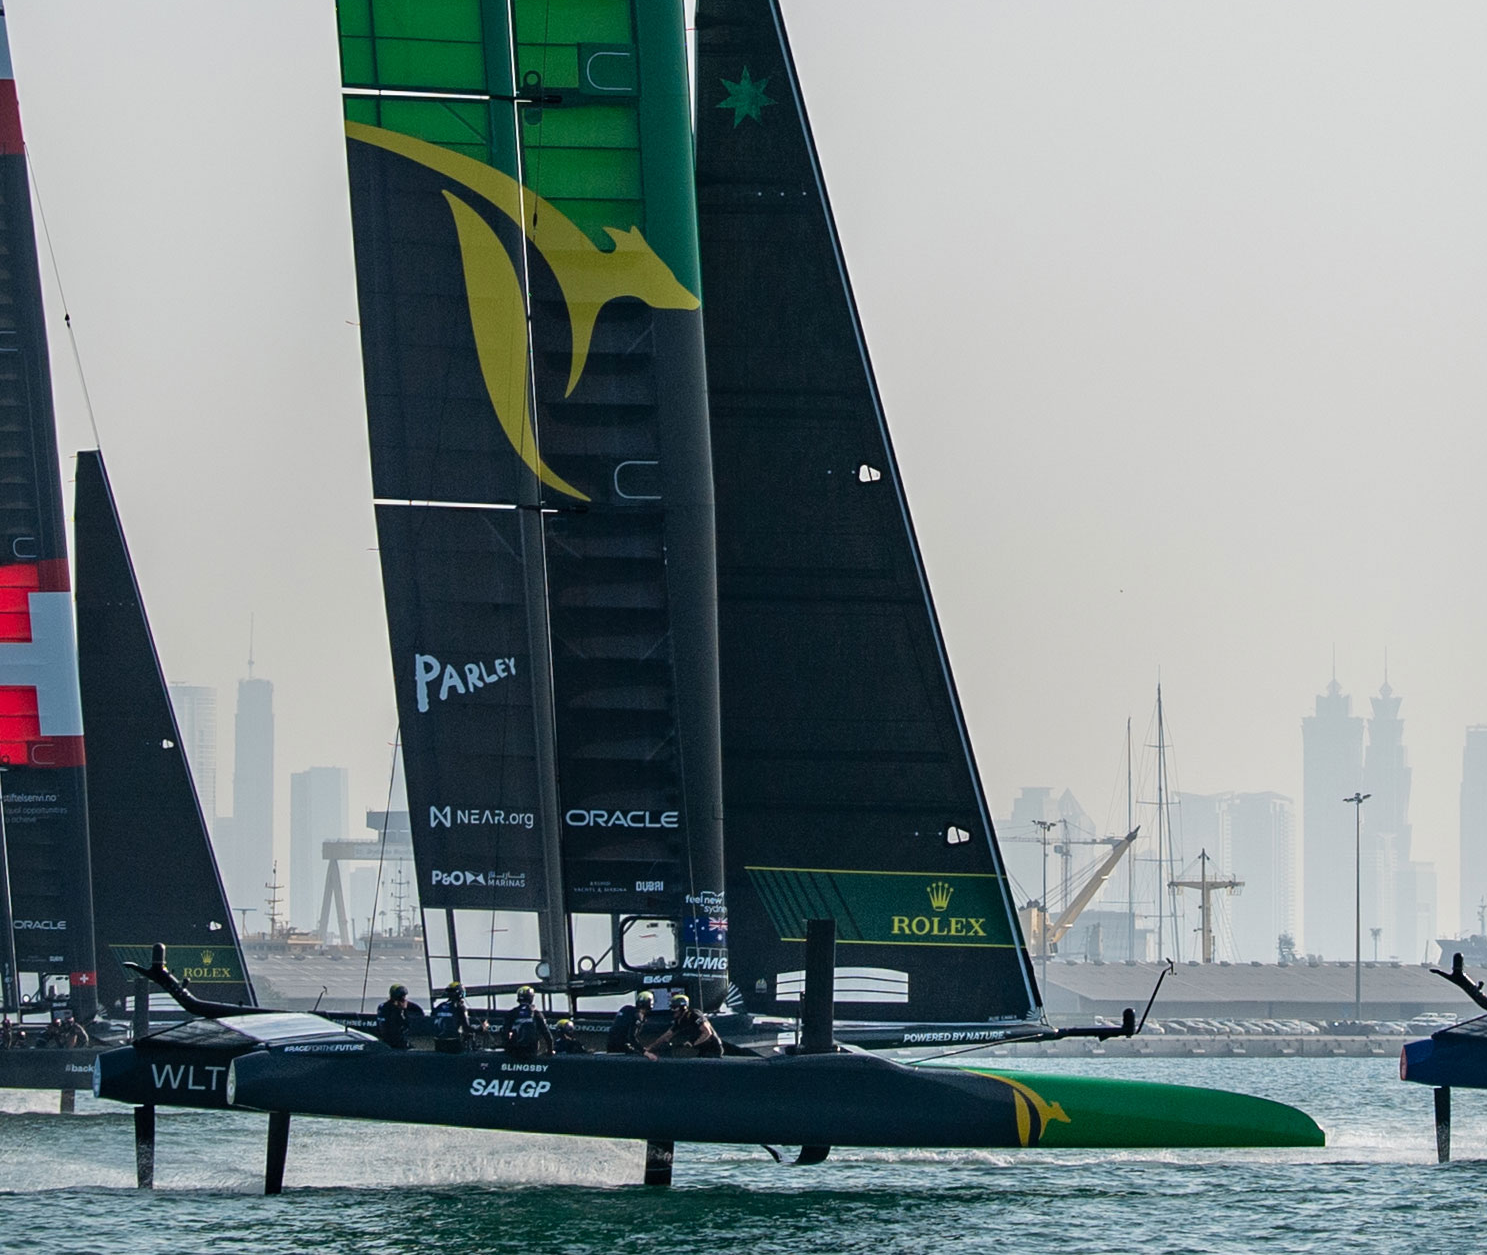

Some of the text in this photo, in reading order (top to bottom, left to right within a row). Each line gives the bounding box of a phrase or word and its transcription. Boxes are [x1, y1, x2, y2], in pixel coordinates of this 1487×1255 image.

[457, 808, 534, 830] NEAR.org
[565, 809, 679, 828] ORACLE
[432, 870, 465, 886] P&O
[488, 879, 526, 887] MARINAS
[635, 880, 664, 893] DUBAI
[13, 920, 67, 930] ORACLE
[891, 915, 986, 937] ROLEX
[682, 956, 728, 971] KPMG
[183, 967, 232, 978] ROLEX
[903, 1032, 952, 1043] POWERED
[951, 1031, 966, 1041] BY
[500, 1063, 549, 1073] SLINGSBY
[151, 1063, 226, 1091] WLT
